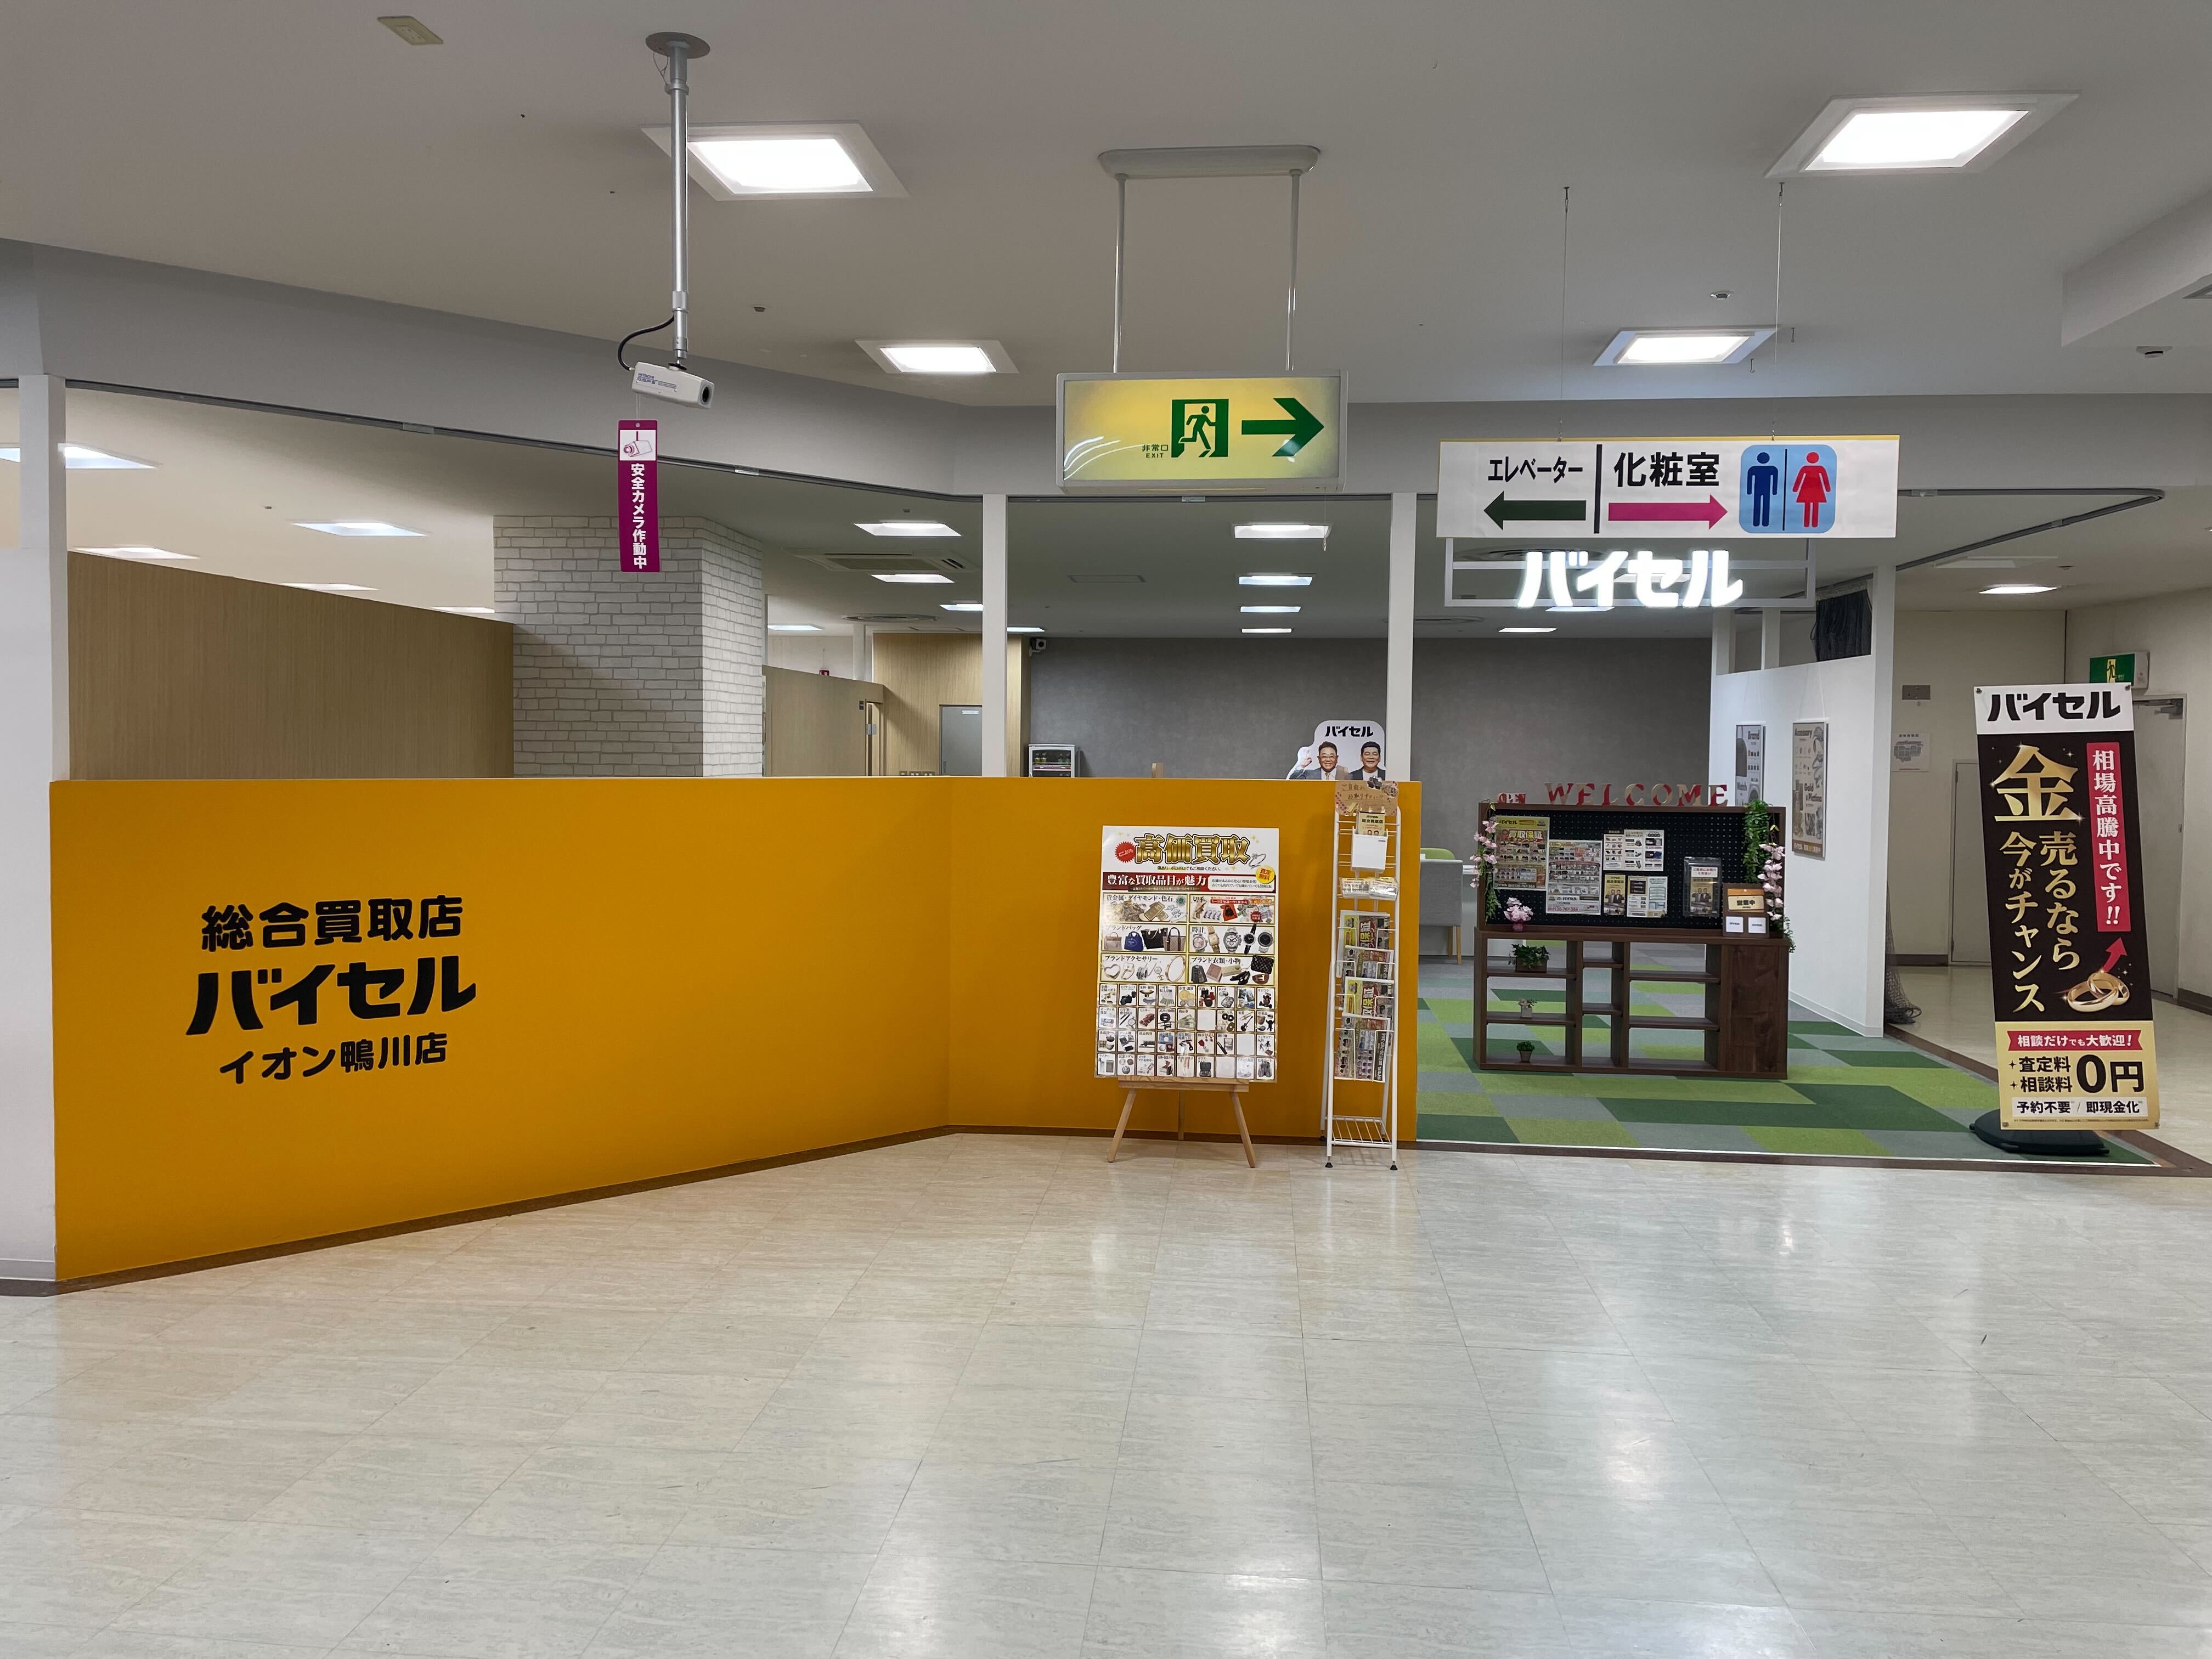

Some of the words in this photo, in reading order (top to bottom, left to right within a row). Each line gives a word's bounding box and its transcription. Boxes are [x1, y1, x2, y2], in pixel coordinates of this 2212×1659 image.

[1488, 456, 1583, 483] エレベーター
[1614, 452, 1720, 488] 化粧室
[631, 462, 647, 569] 安全カメラ作動中
[1517, 550, 1744, 608] バイセル
[1987, 691, 2121, 721] バイセル
[1325, 726, 1374, 737] バイセル
[1497, 792, 1527, 804] OPEN
[1544, 783, 1729, 807] WELCOME
[1994, 744, 2079, 822] 金
[1133, 833, 1251, 865] 高価買取
[2092, 749, 2122, 926] 相場高騰中です!!
[1107, 874, 1206, 886] 豊富な買取品目が魅力
[2039, 830, 2081, 970] 売るなら
[201, 894, 463, 952] 総合買取店
[2000, 830, 2045, 1013] 今がチャンス
[185, 955, 476, 1036] バイセル
[219, 1032, 447, 1085] イオン鴨川店
[2017, 1034, 2132, 1047] 相談だけでも大歓迎!
[2018, 1056, 2072, 1073] 査定料
[2076, 1054, 2145, 1093] 0円
[2020, 1076, 2073, 1093] 相談料
[2017, 1101, 2071, 1114] 予約不要
[2086, 1101, 2140, 1114] 即現金化
